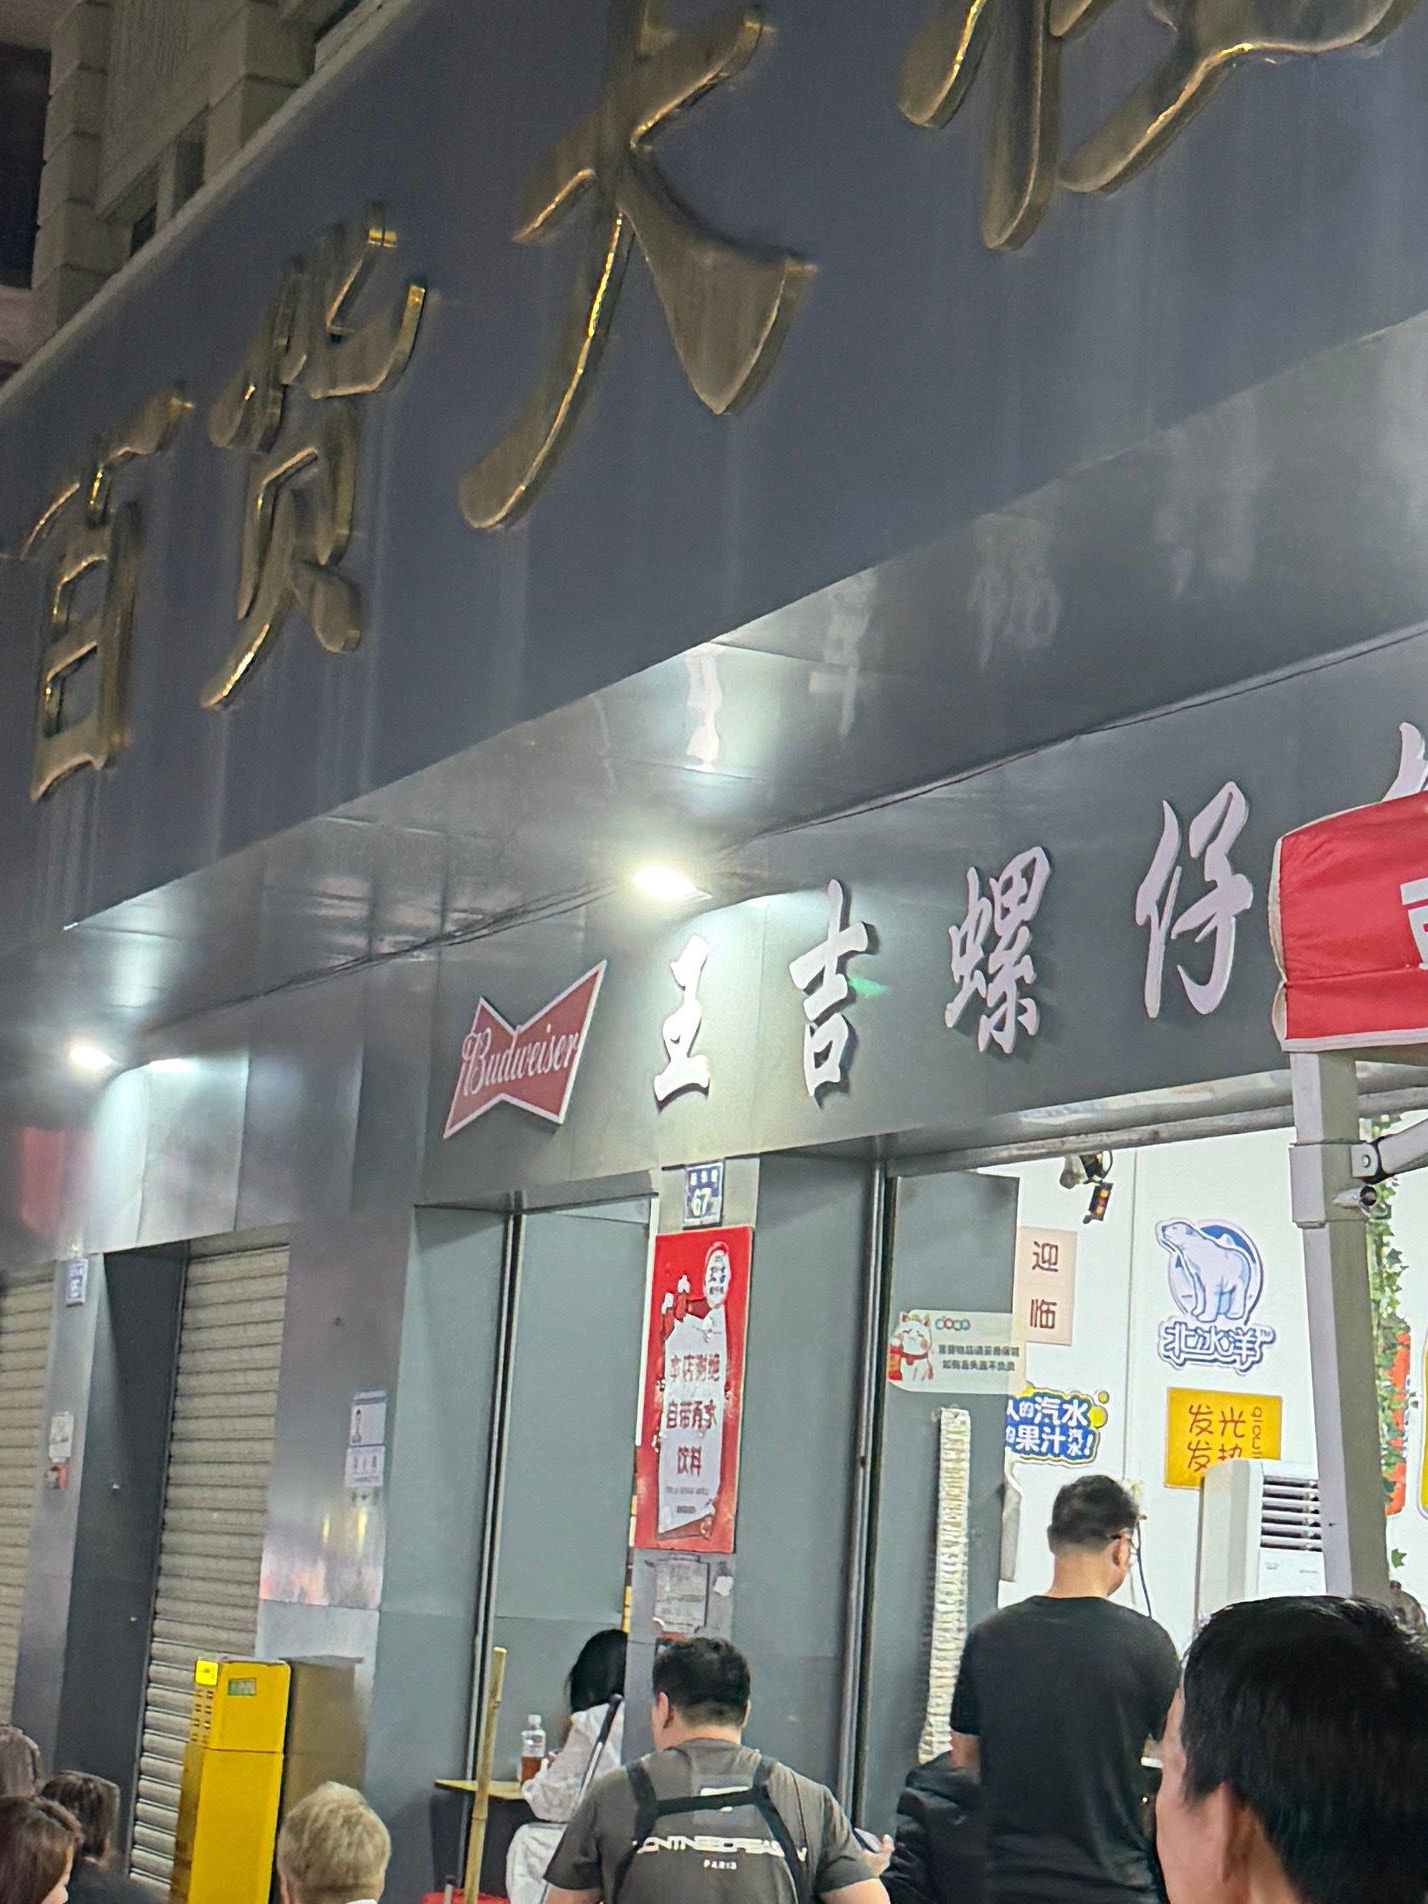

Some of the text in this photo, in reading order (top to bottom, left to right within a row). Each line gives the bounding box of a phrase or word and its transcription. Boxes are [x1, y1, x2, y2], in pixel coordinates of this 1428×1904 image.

[462, 1024, 580, 1096] Budweiser
[692, 1187, 712, 1216] 67
[1164, 1321, 1259, 1366] 北冰洋
[1189, 1404, 1246, 1438] 发光
[677, 1446, 702, 1476] 饮料
